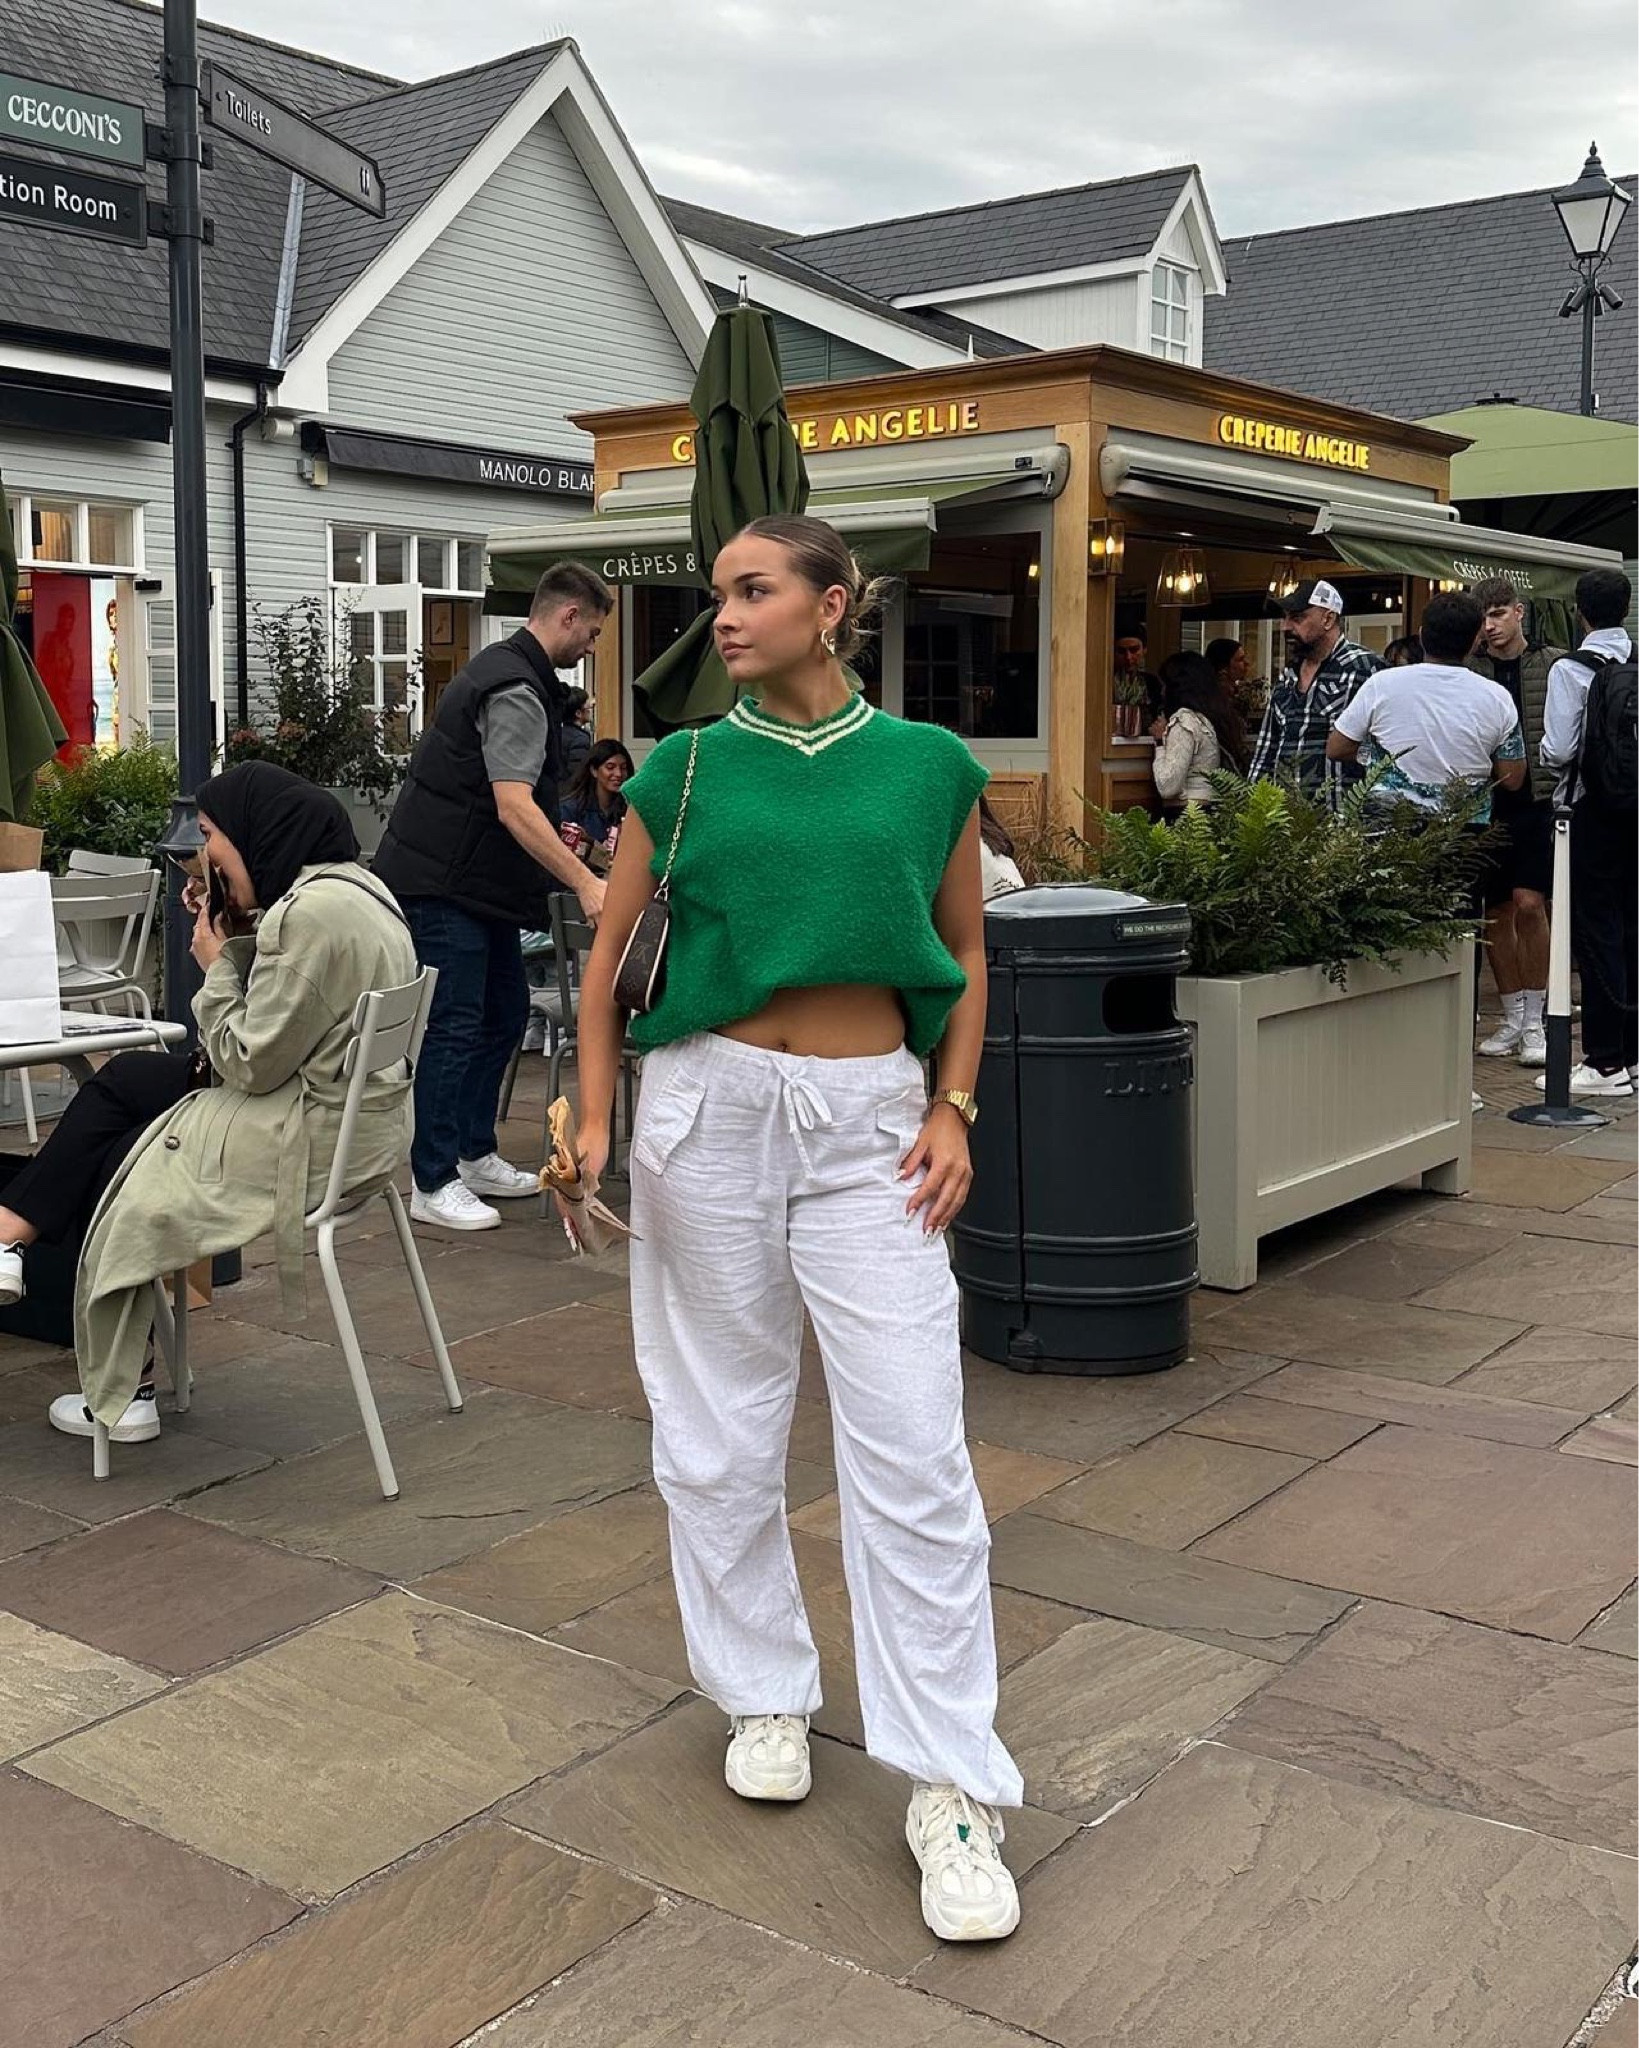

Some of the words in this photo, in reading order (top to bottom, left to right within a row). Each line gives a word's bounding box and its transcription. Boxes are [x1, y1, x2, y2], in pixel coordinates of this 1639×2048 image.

[8, 95, 122, 144] CECCONI'S
[226, 90, 271, 135] Toilets
[0, 174, 45, 206] tion
[54, 184, 118, 221] Room
[831, 402, 979, 445] ANGELIE
[1220, 415, 1301, 455] CREPERIE
[1305, 434, 1369, 470] ANGELIE
[480, 459, 551, 486] MANOLO
[603, 552, 677, 577] CRÊPES
